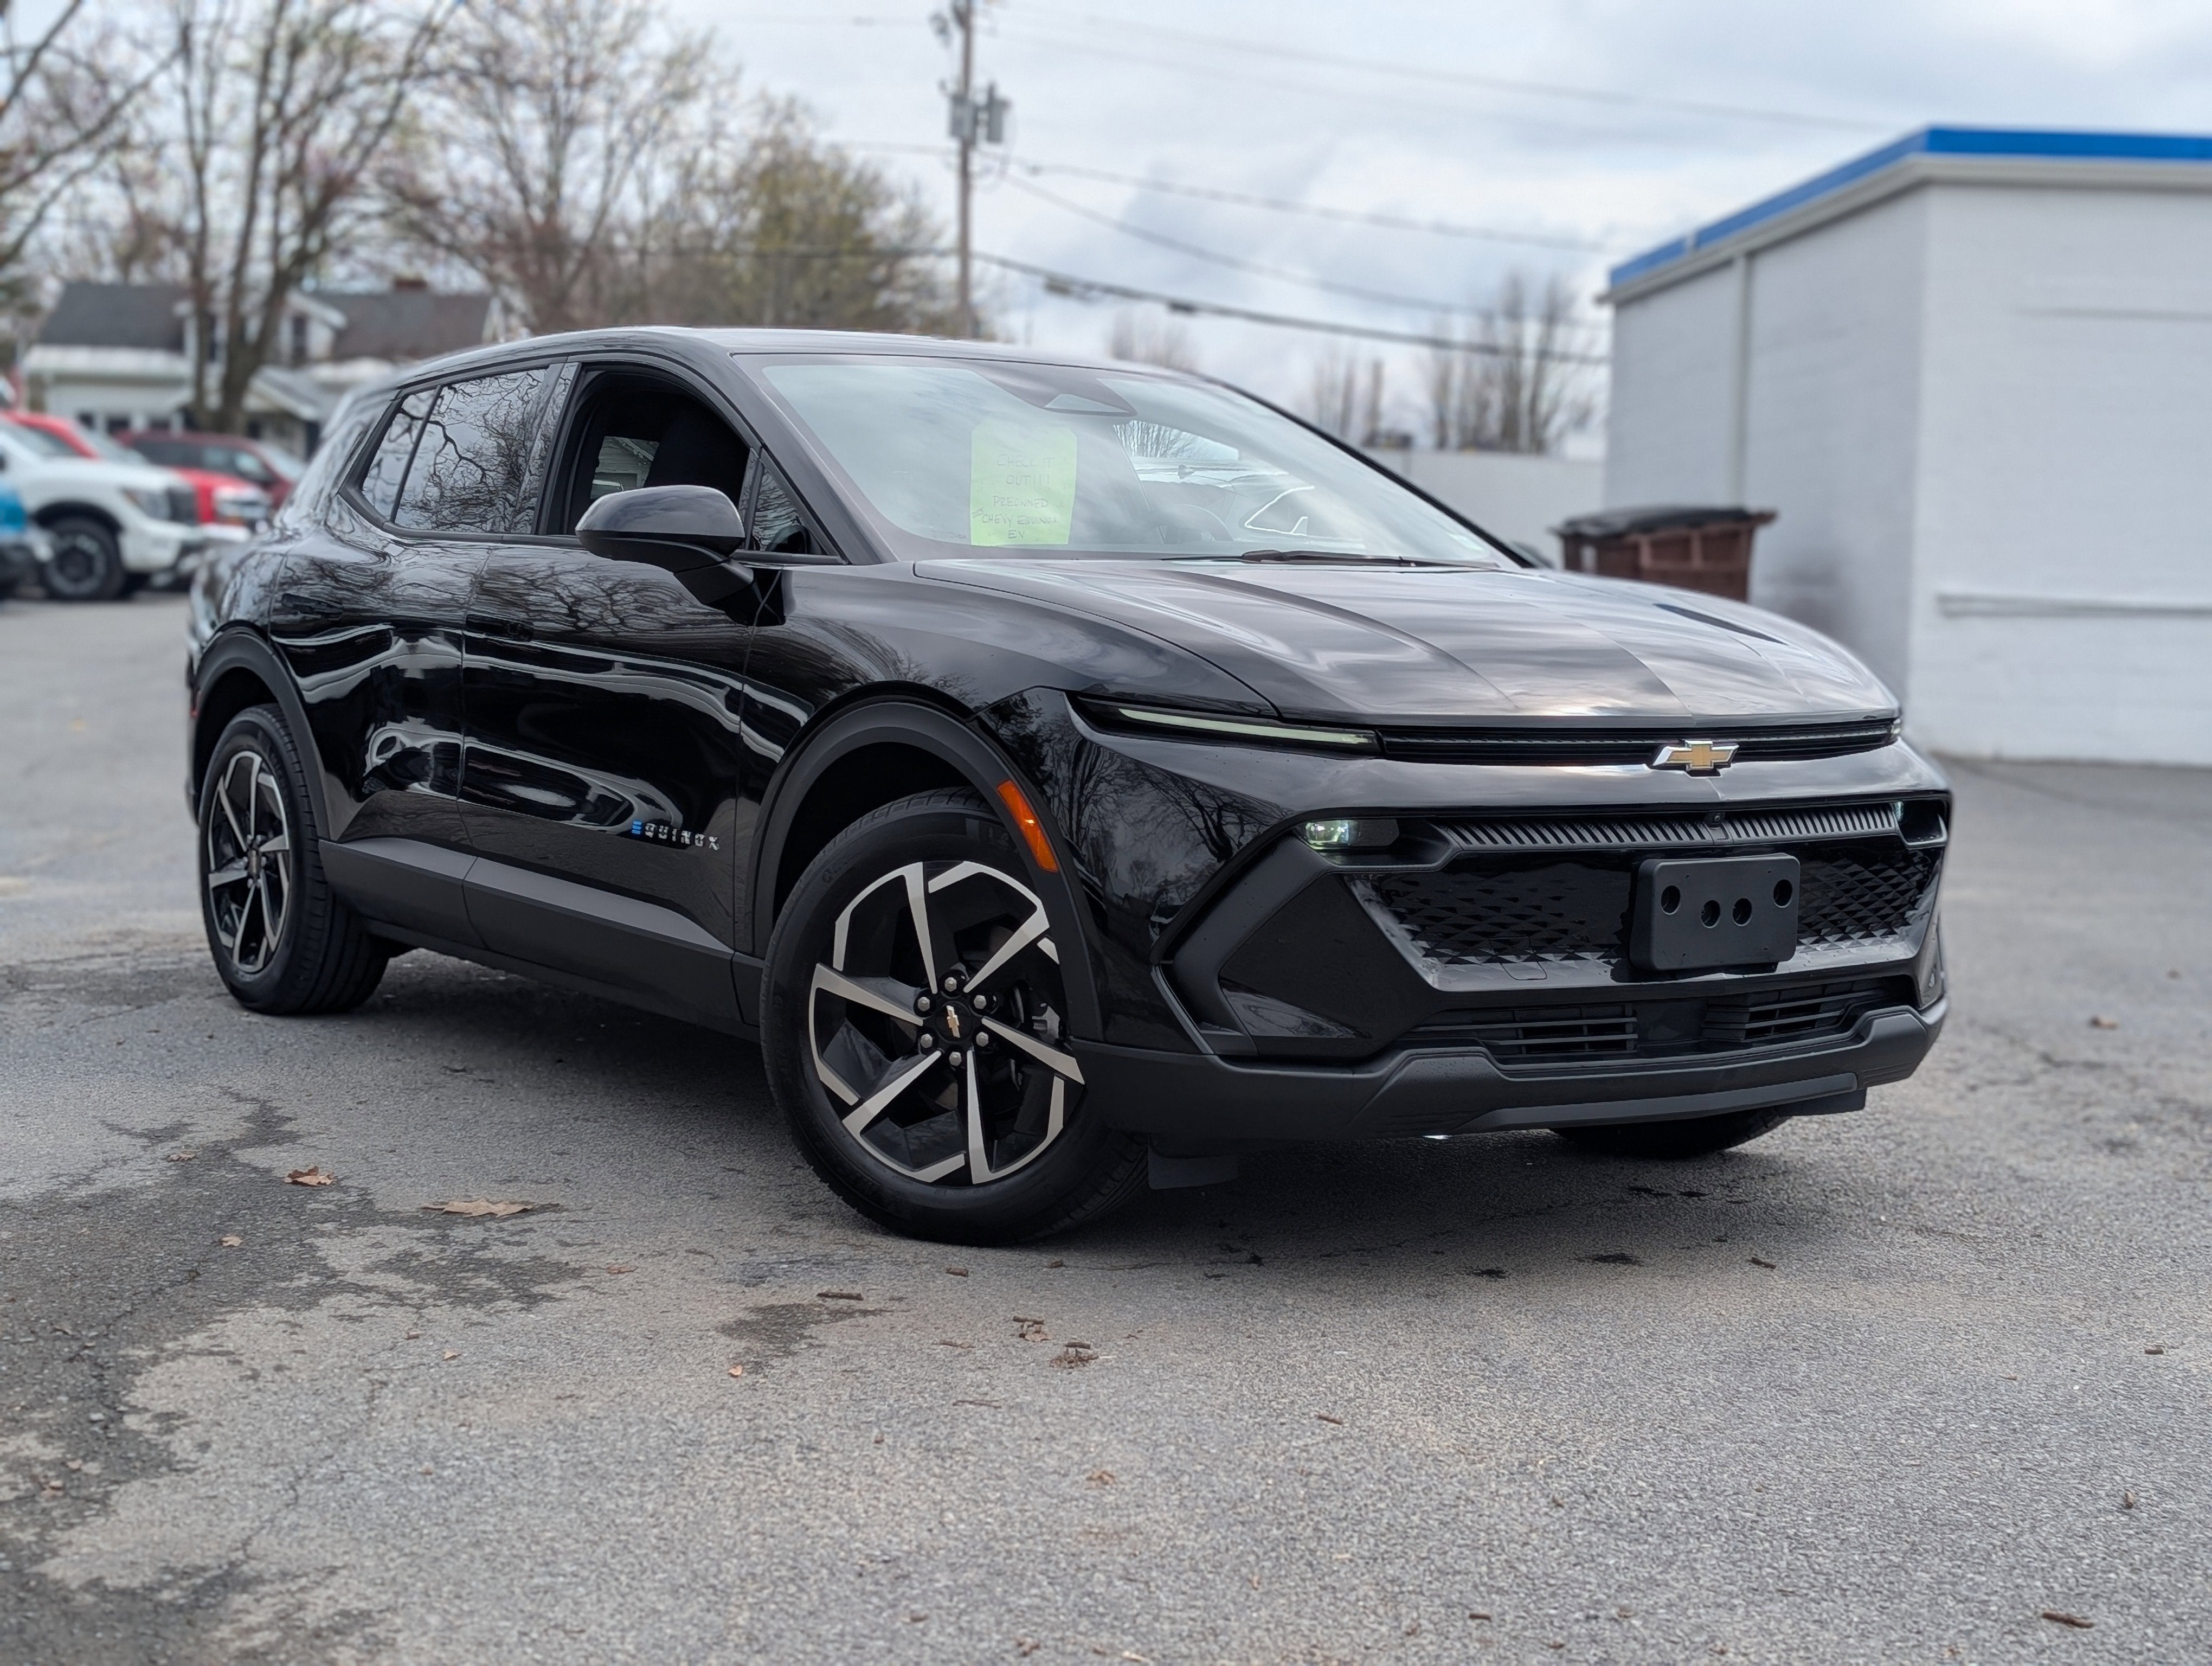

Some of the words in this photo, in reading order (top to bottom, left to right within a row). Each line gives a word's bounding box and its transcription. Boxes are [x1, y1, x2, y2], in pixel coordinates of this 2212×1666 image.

[997, 453, 1037, 467] CHECK
[1043, 457, 1055, 468] IT
[981, 513, 1014, 528] CHEVY
[1008, 529, 1025, 539] EV
[631, 821, 720, 851] EQUINOX
